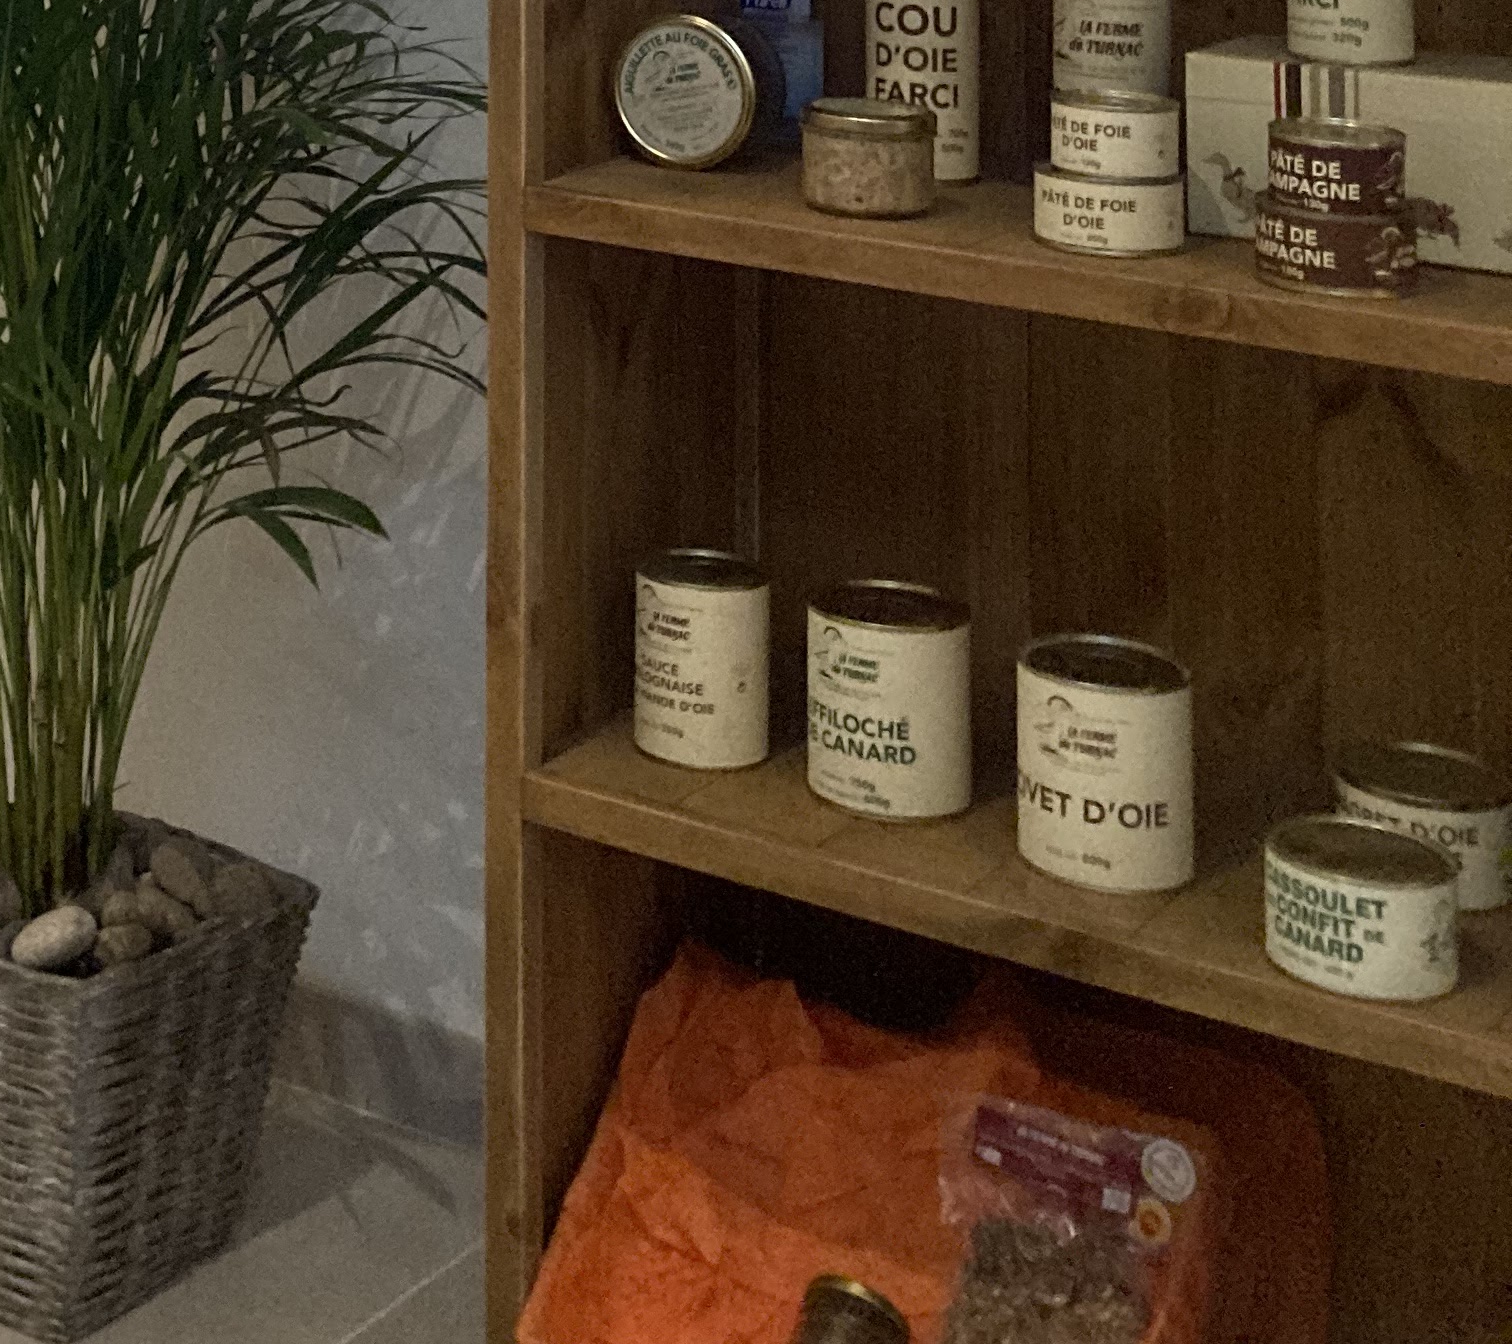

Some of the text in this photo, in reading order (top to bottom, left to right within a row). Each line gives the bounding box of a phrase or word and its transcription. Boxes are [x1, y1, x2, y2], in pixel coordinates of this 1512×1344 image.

[875, 1, 958, 38] COU
[1095, 21, 1144, 38] FERME
[876, 42, 958, 73] D'OIE
[874, 77, 959, 110] FARCI
[1062, 134, 1098, 152] D'OIE
[1071, 120, 1088, 135] DE
[1094, 124, 1131, 140] FOIE
[1311, 160, 1342, 180] DE
[1074, 196, 1094, 211] DE
[1100, 199, 1137, 213] FOIE
[1063, 215, 1105, 230] D'OIE
[1289, 224, 1318, 247] DE
[821, 729, 916, 765] CANARD
[1083, 798, 1170, 831] D'OIE
[1268, 865, 1387, 920] ASSOULET
[1276, 893, 1356, 940] CONFIT
[1274, 913, 1364, 963] CANARD
